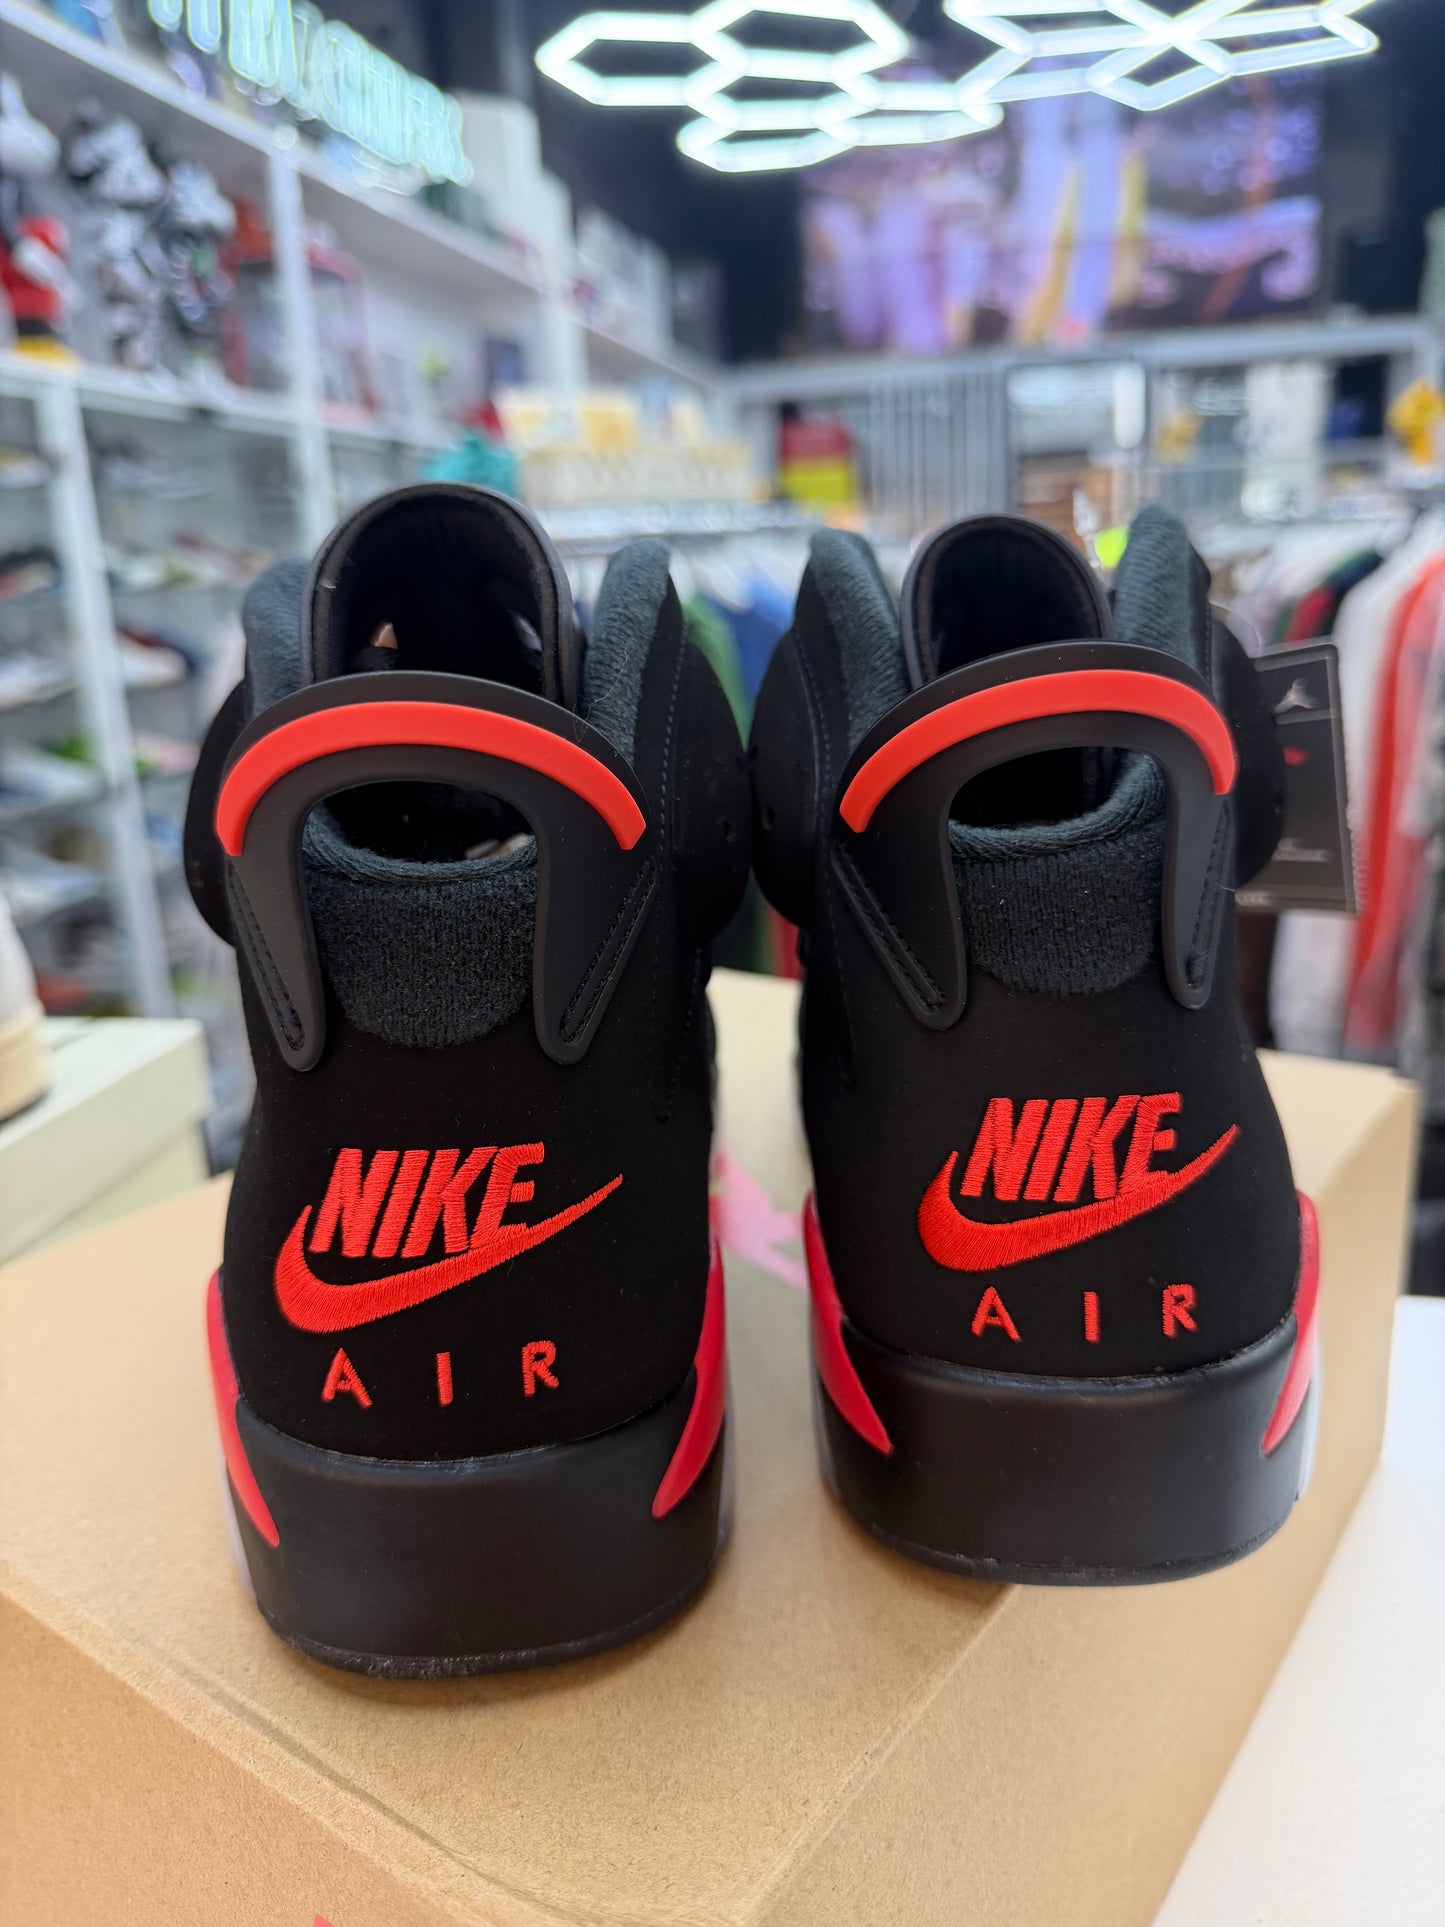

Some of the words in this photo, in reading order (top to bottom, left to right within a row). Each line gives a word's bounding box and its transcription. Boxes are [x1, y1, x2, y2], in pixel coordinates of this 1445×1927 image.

[960, 1091, 1181, 1202] NIKE
[308, 1141, 545, 1258] NIKE
[970, 1284, 1197, 1342] AIR
[321, 1340, 560, 1409] AIR
